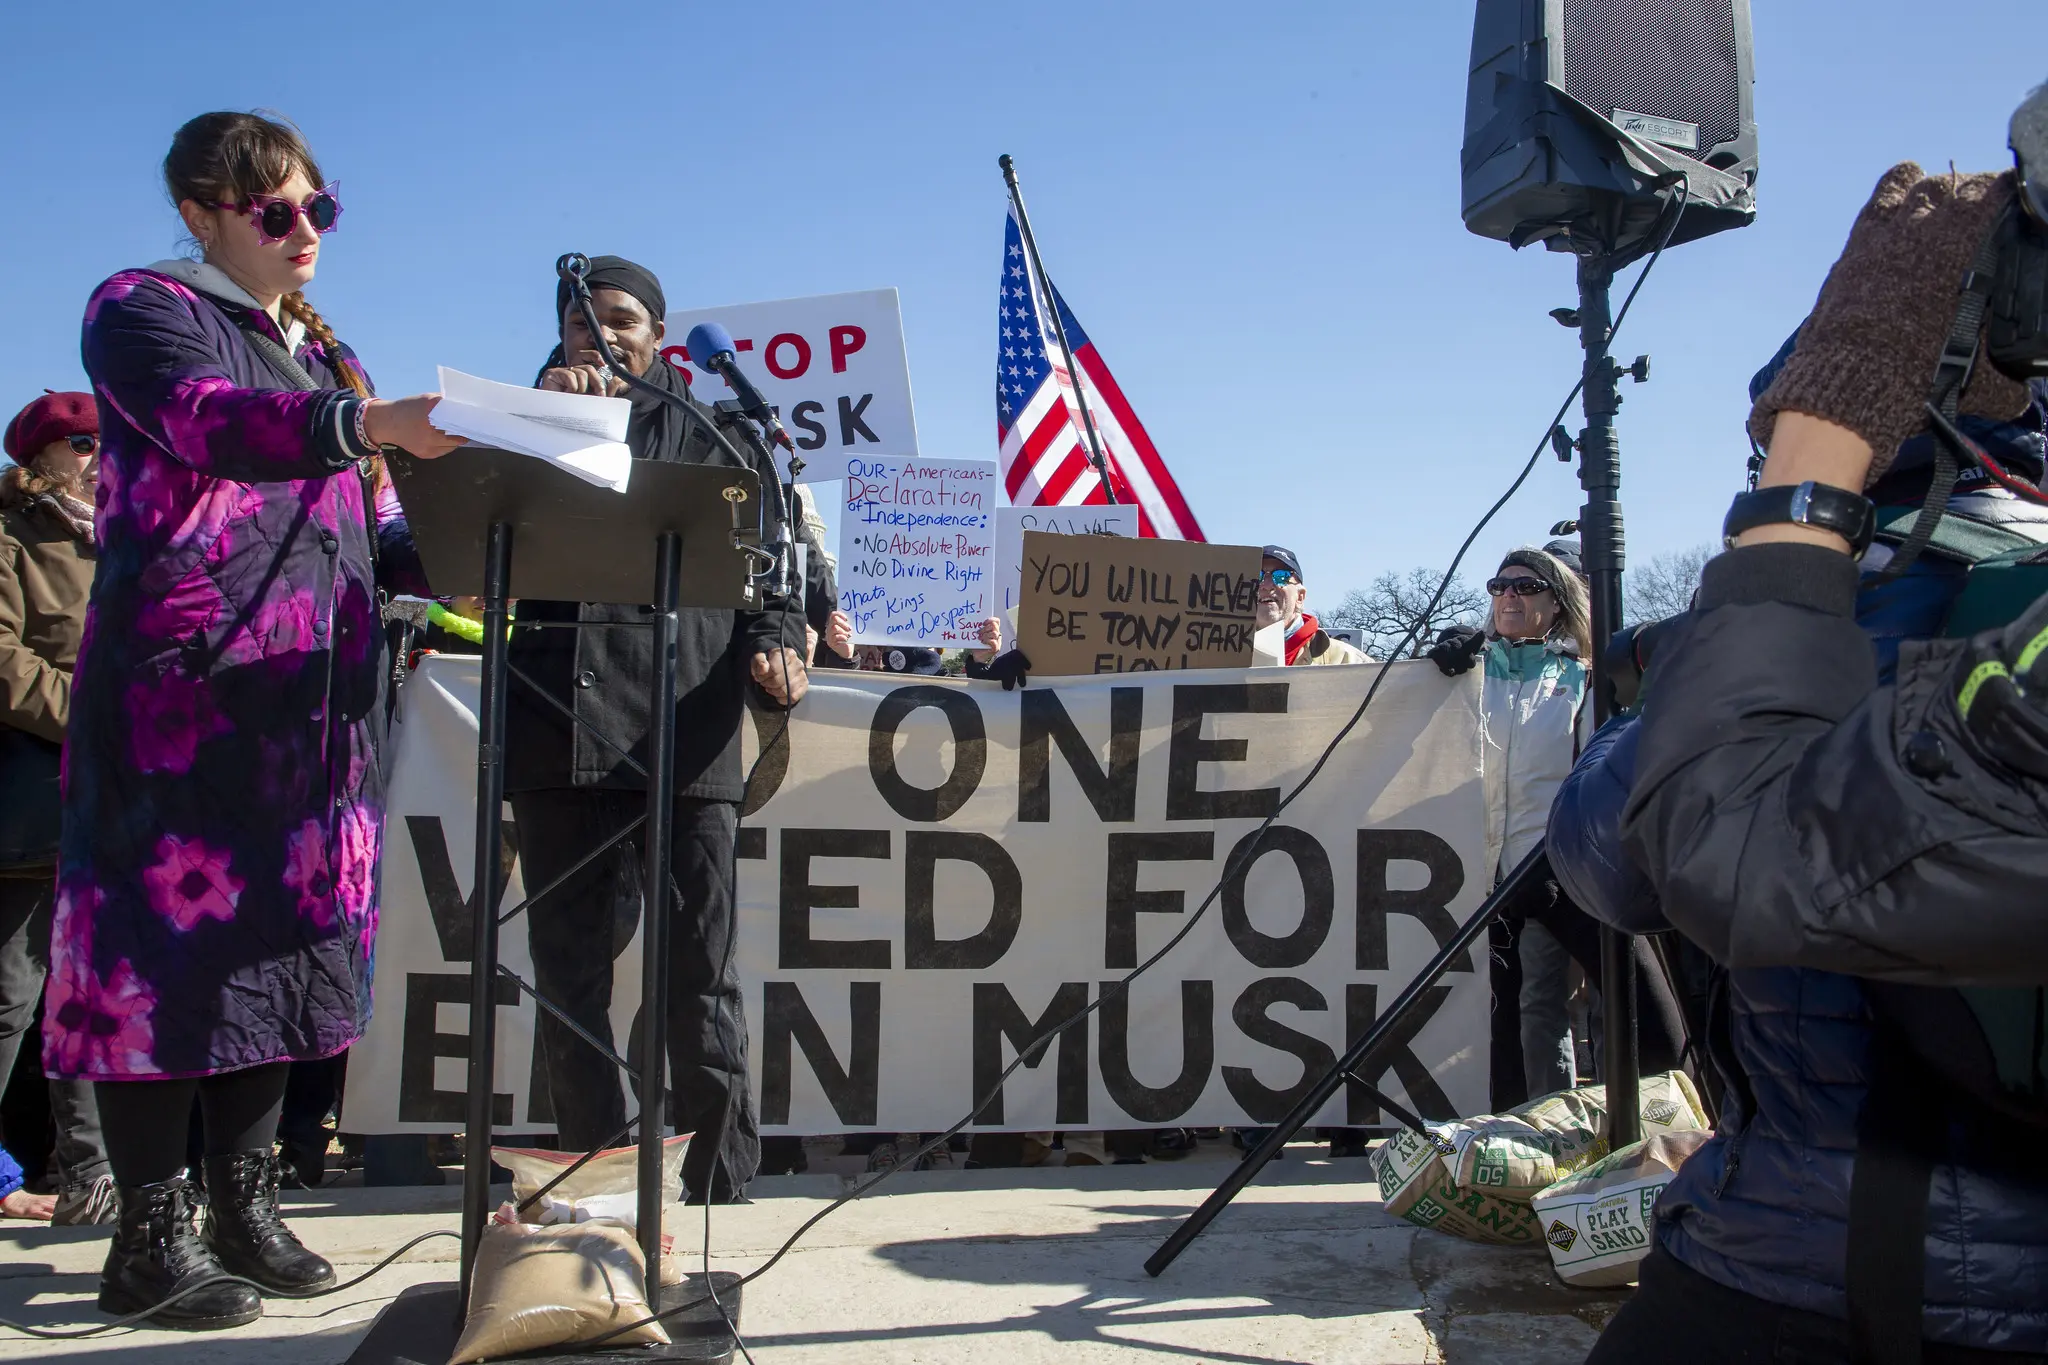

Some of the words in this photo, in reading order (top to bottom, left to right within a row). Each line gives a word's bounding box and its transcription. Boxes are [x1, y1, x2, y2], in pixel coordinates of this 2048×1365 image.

[1647, 123, 1689, 137] ESCORT
[847, 476, 982, 511] Declaration
[848, 499, 863, 512] of
[861, 501, 987, 532] Independence:
[889, 533, 953, 557] Absolute
[955, 533, 992, 559] Power
[891, 558, 940, 581] Divine
[945, 560, 983, 592] Right
[1029, 554, 1090, 598] YOU
[1107, 563, 1179, 605] WILL
[1187, 571, 1260, 613] NEVER
[886, 592, 925, 619] Kings
[886, 620, 915, 636] and
[941, 632, 957, 641] the
[958, 617, 984, 631] Save
[1045, 606, 1089, 642] BE
[1099, 611, 1181, 651] TONY
[1185, 620, 1255, 653] STARK
[869, 682, 1290, 823] ONE
[404, 815, 1023, 969] VED
[1104, 825, 1475, 973] FOR
[398, 972, 882, 1126] EN
[972, 976, 1462, 1127] MUSK
[1476, 1165, 1504, 1186] 50
[1415, 1197, 1444, 1220] 50
[1586, 1206, 1630, 1231] PLAY
[1590, 1226, 1646, 1251] SAND
